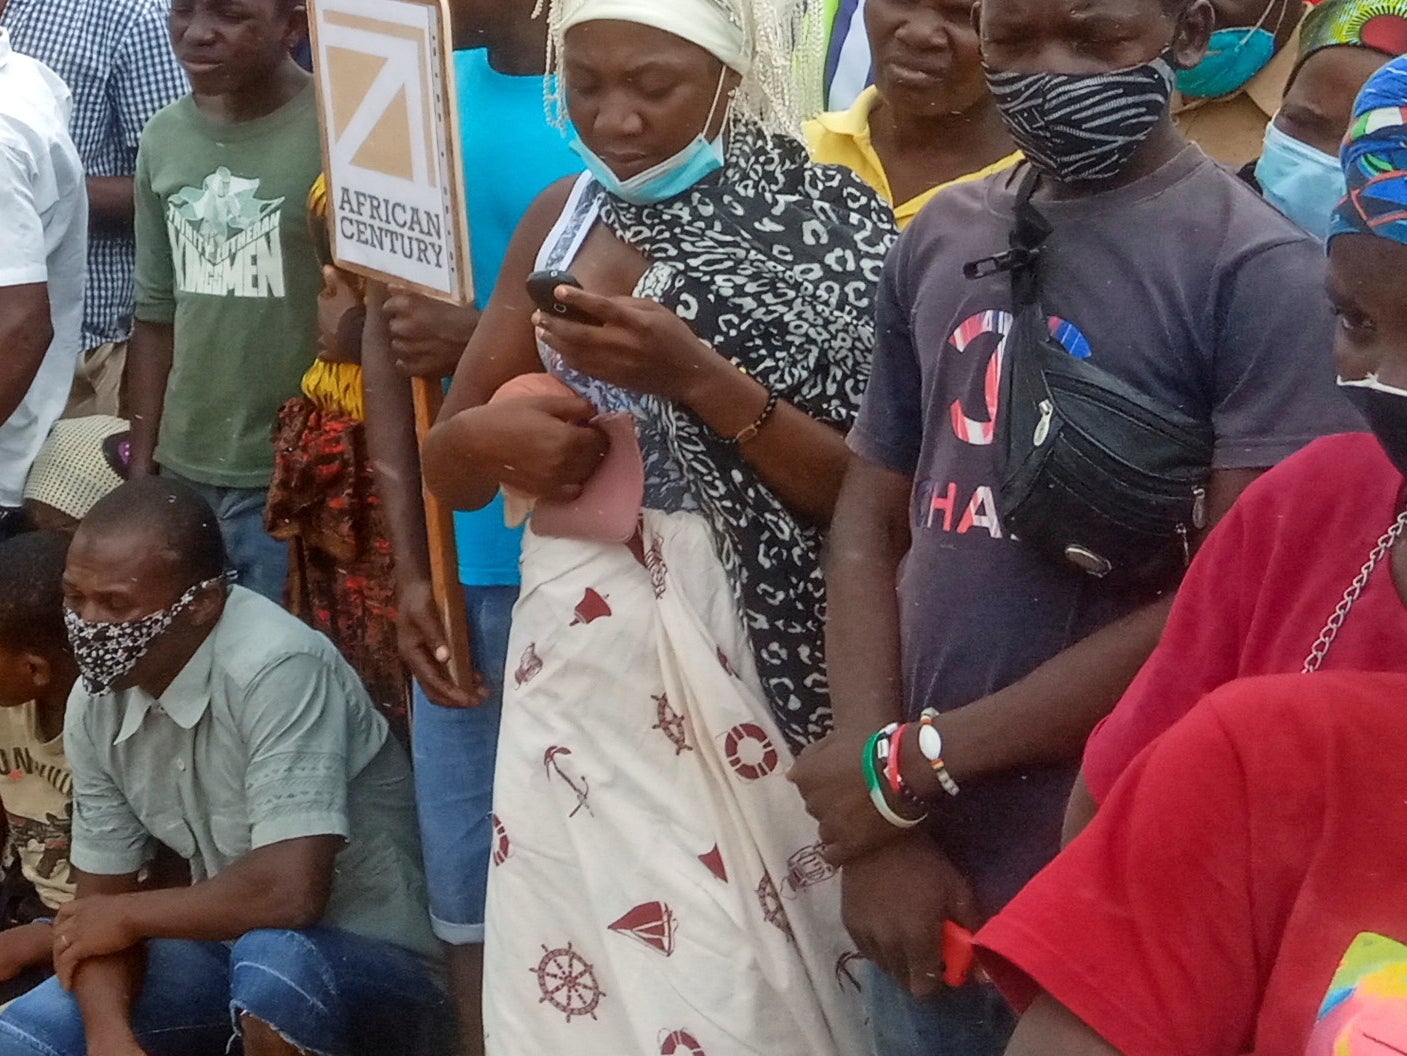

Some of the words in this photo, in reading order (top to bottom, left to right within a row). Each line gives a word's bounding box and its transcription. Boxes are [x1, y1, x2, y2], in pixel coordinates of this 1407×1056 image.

[338, 186, 442, 241] AFRICAN
[339, 215, 443, 269] CENTURY
[916, 481, 1020, 541] CHA
